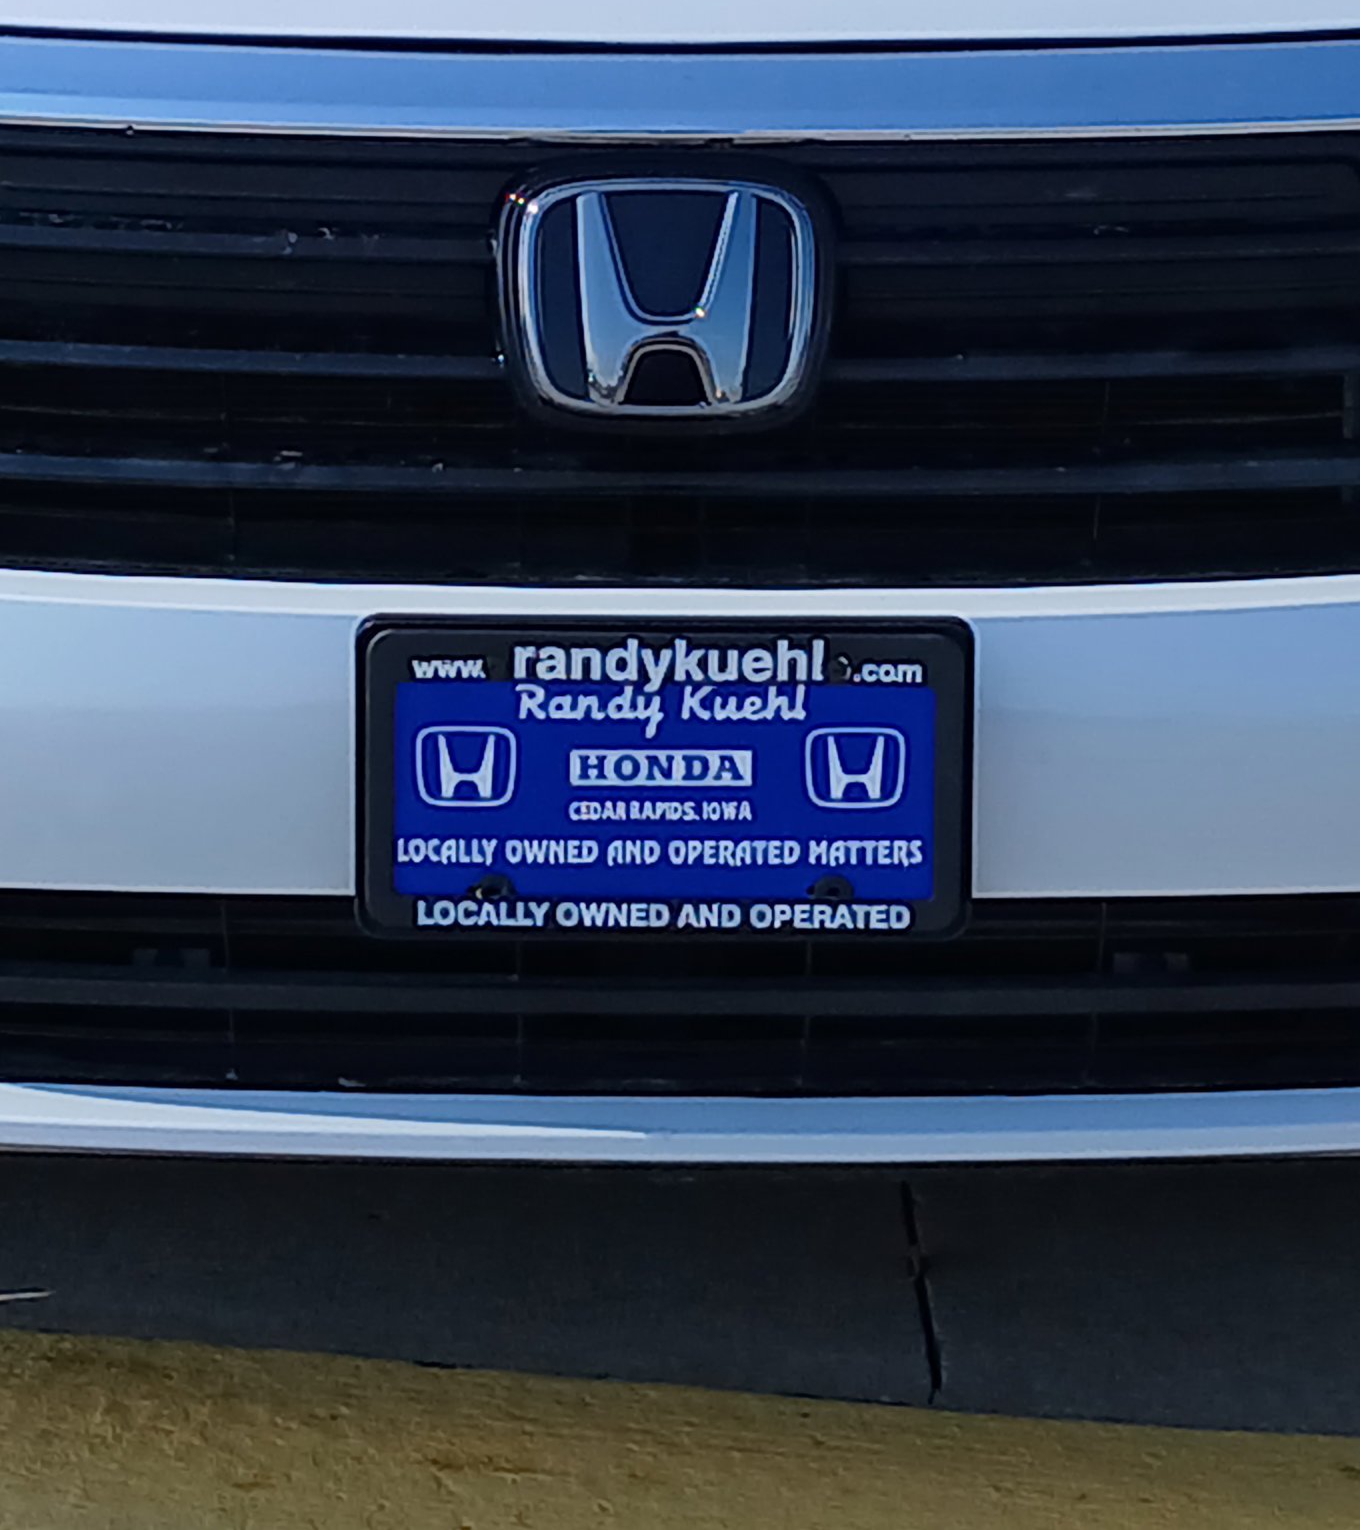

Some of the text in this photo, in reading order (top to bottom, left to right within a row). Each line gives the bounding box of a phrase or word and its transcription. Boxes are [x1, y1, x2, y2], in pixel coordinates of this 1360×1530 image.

[513, 638, 825, 692] randykuehl
[515, 683, 807, 739] Randy Kuehl
[577, 754, 745, 782] HONDA
[702, 801, 752, 821] IOWA
[397, 838, 922, 867] LOCALLY OWNED AND OPERATED MATTERS
[417, 900, 911, 930] LOCALLY OWNED AND OPERATED
